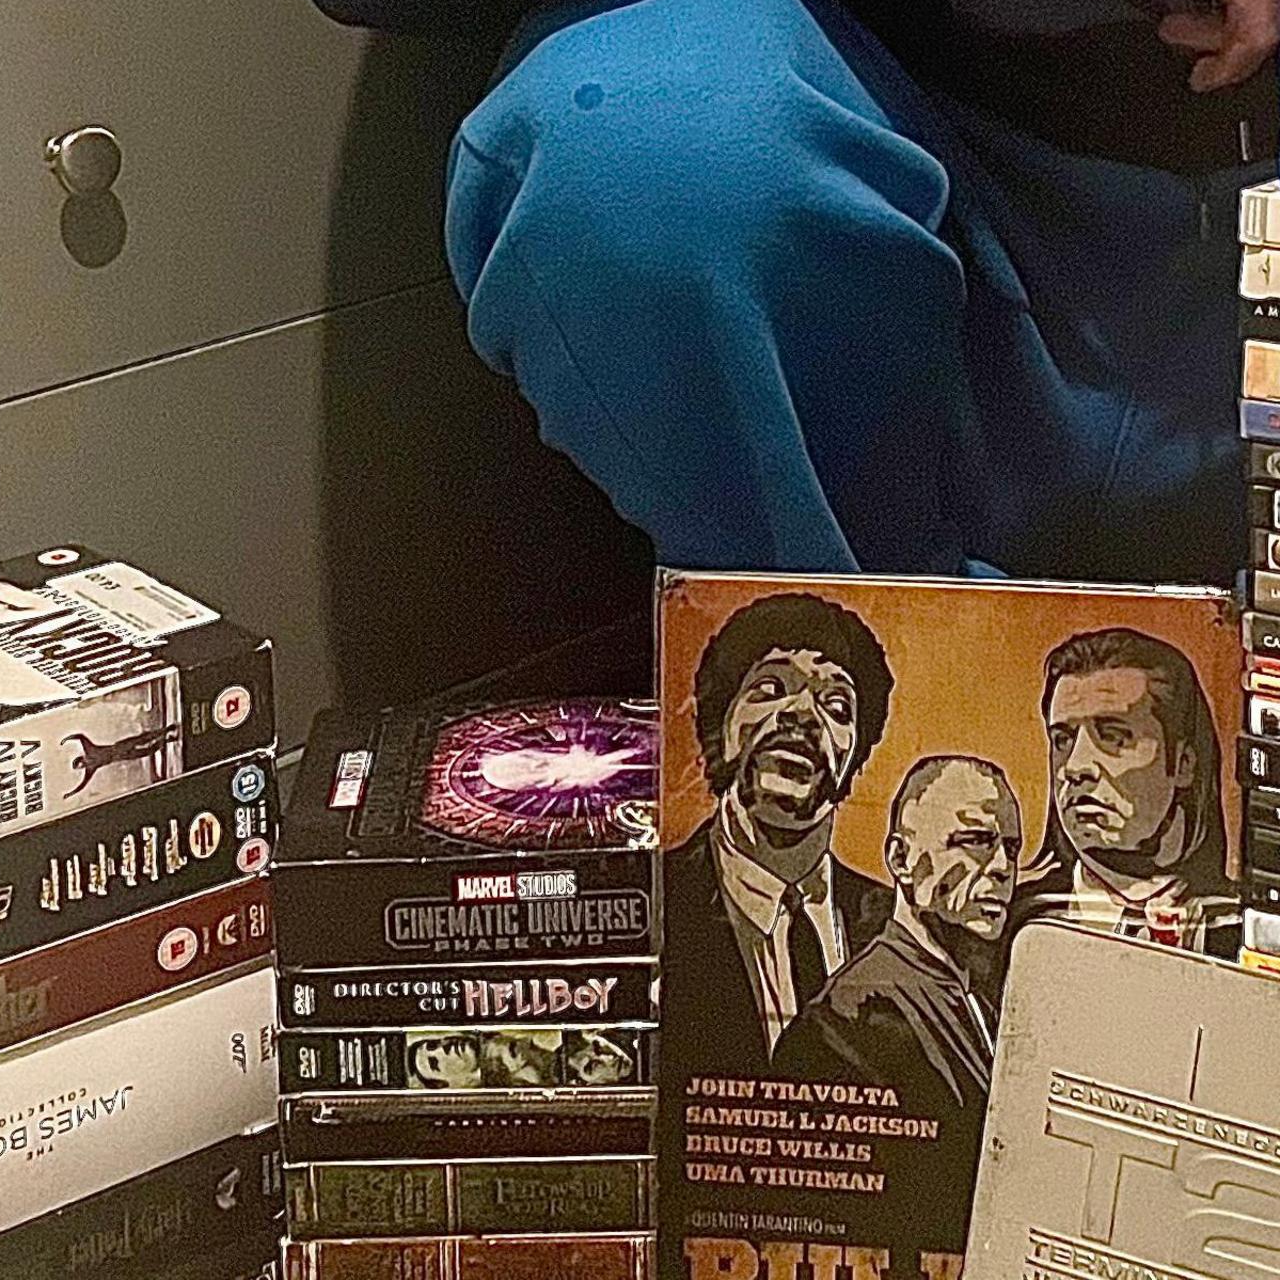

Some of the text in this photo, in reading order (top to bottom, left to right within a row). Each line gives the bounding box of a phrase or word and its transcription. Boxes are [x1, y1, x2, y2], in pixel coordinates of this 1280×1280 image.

[1254, 305, 1264, 316] A
[20, 740, 44, 816] ROCKY V
[243, 773, 256, 795] 15
[457, 873, 577, 900] MARVEL STUDIOS
[394, 898, 643, 940] CINEMATIC UNIVERSE
[434, 934, 605, 953] PHASE TWO
[334, 980, 460, 998] DIRECTOR'S
[462, 976, 618, 1018] HELLBOY
[419, 997, 460, 1011] CUT
[231, 1032, 247, 1074] 007
[685, 1077, 900, 1107] JOHN TRAVOLTA
[39, 1085, 134, 1140] JAMES
[685, 1106, 939, 1140] SAMUEL L JACKSON
[26, 1144, 54, 1162] THE
[685, 1134, 872, 1163] BRUCE WILLIS
[685, 1163, 885, 1192] UMA THURMAN
[691, 1210, 823, 1235] QUENTIN TARANTINO
